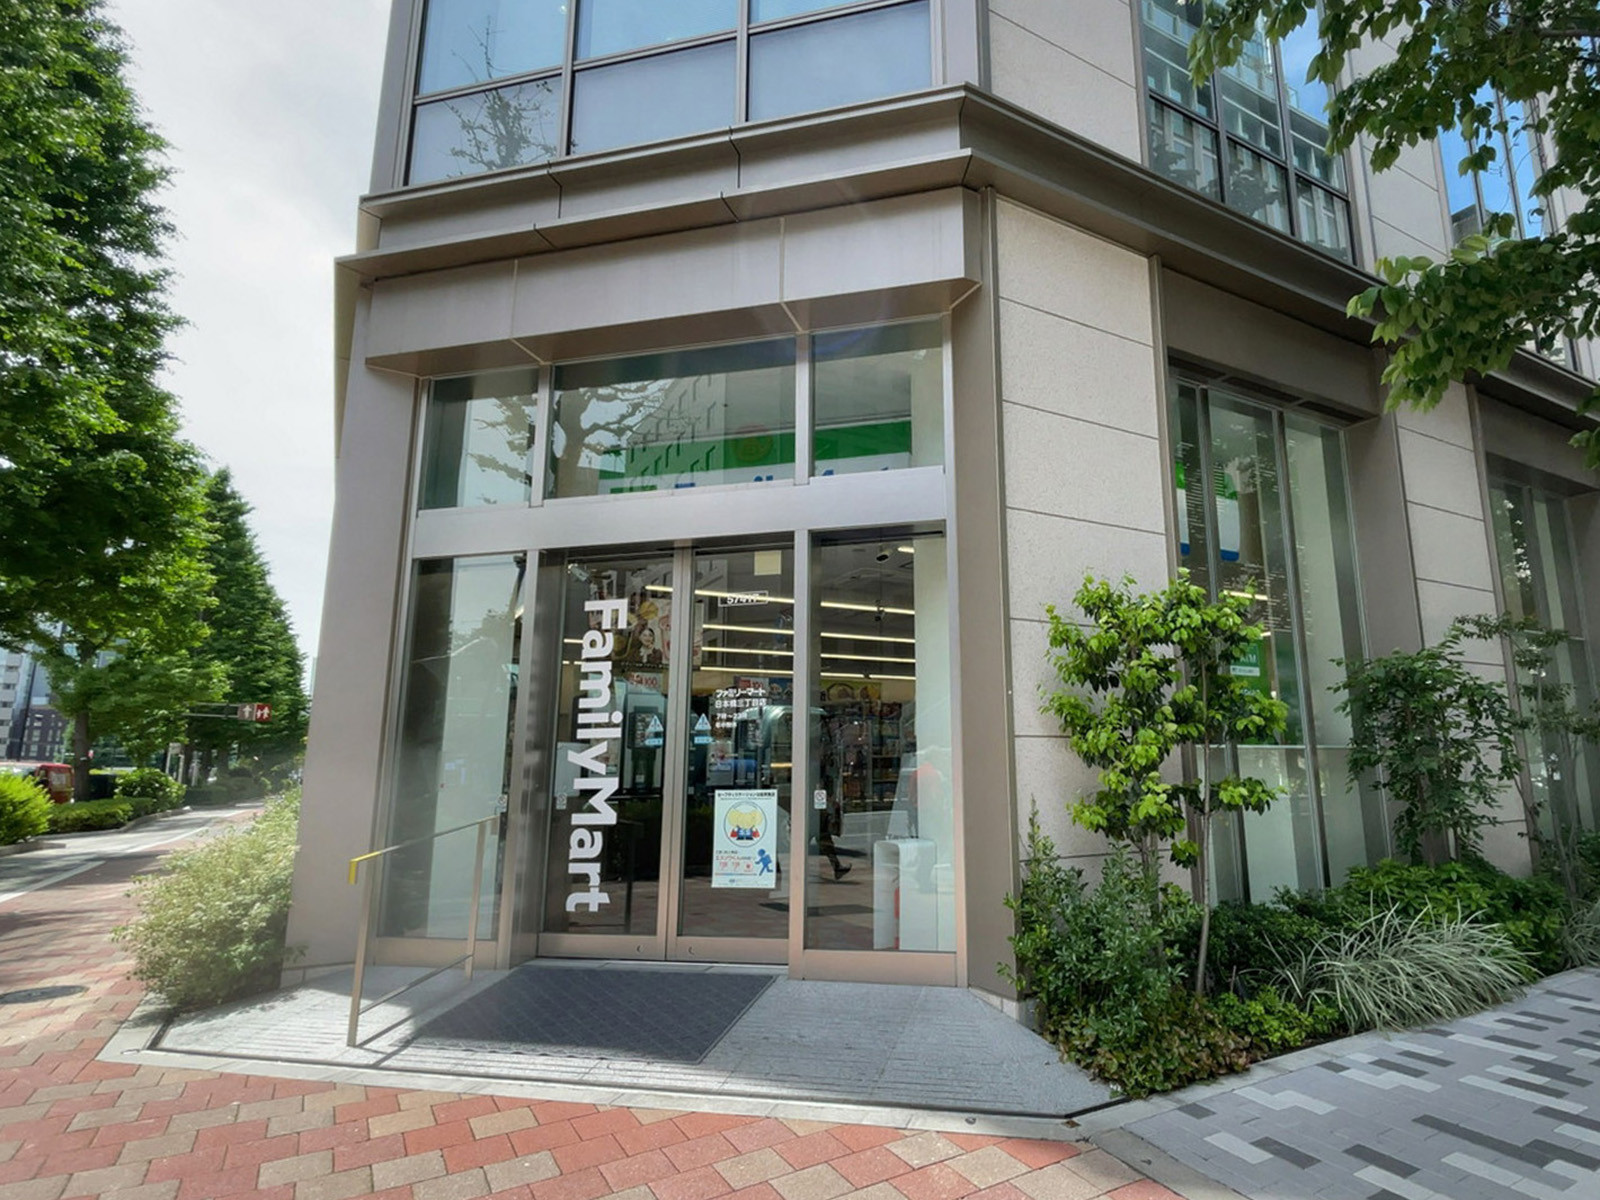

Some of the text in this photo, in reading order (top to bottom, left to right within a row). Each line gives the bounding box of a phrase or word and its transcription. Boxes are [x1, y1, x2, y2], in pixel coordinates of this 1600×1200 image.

[566, 598, 628, 912] FamilyMart
[715, 688, 766, 698] ファミリーマート
